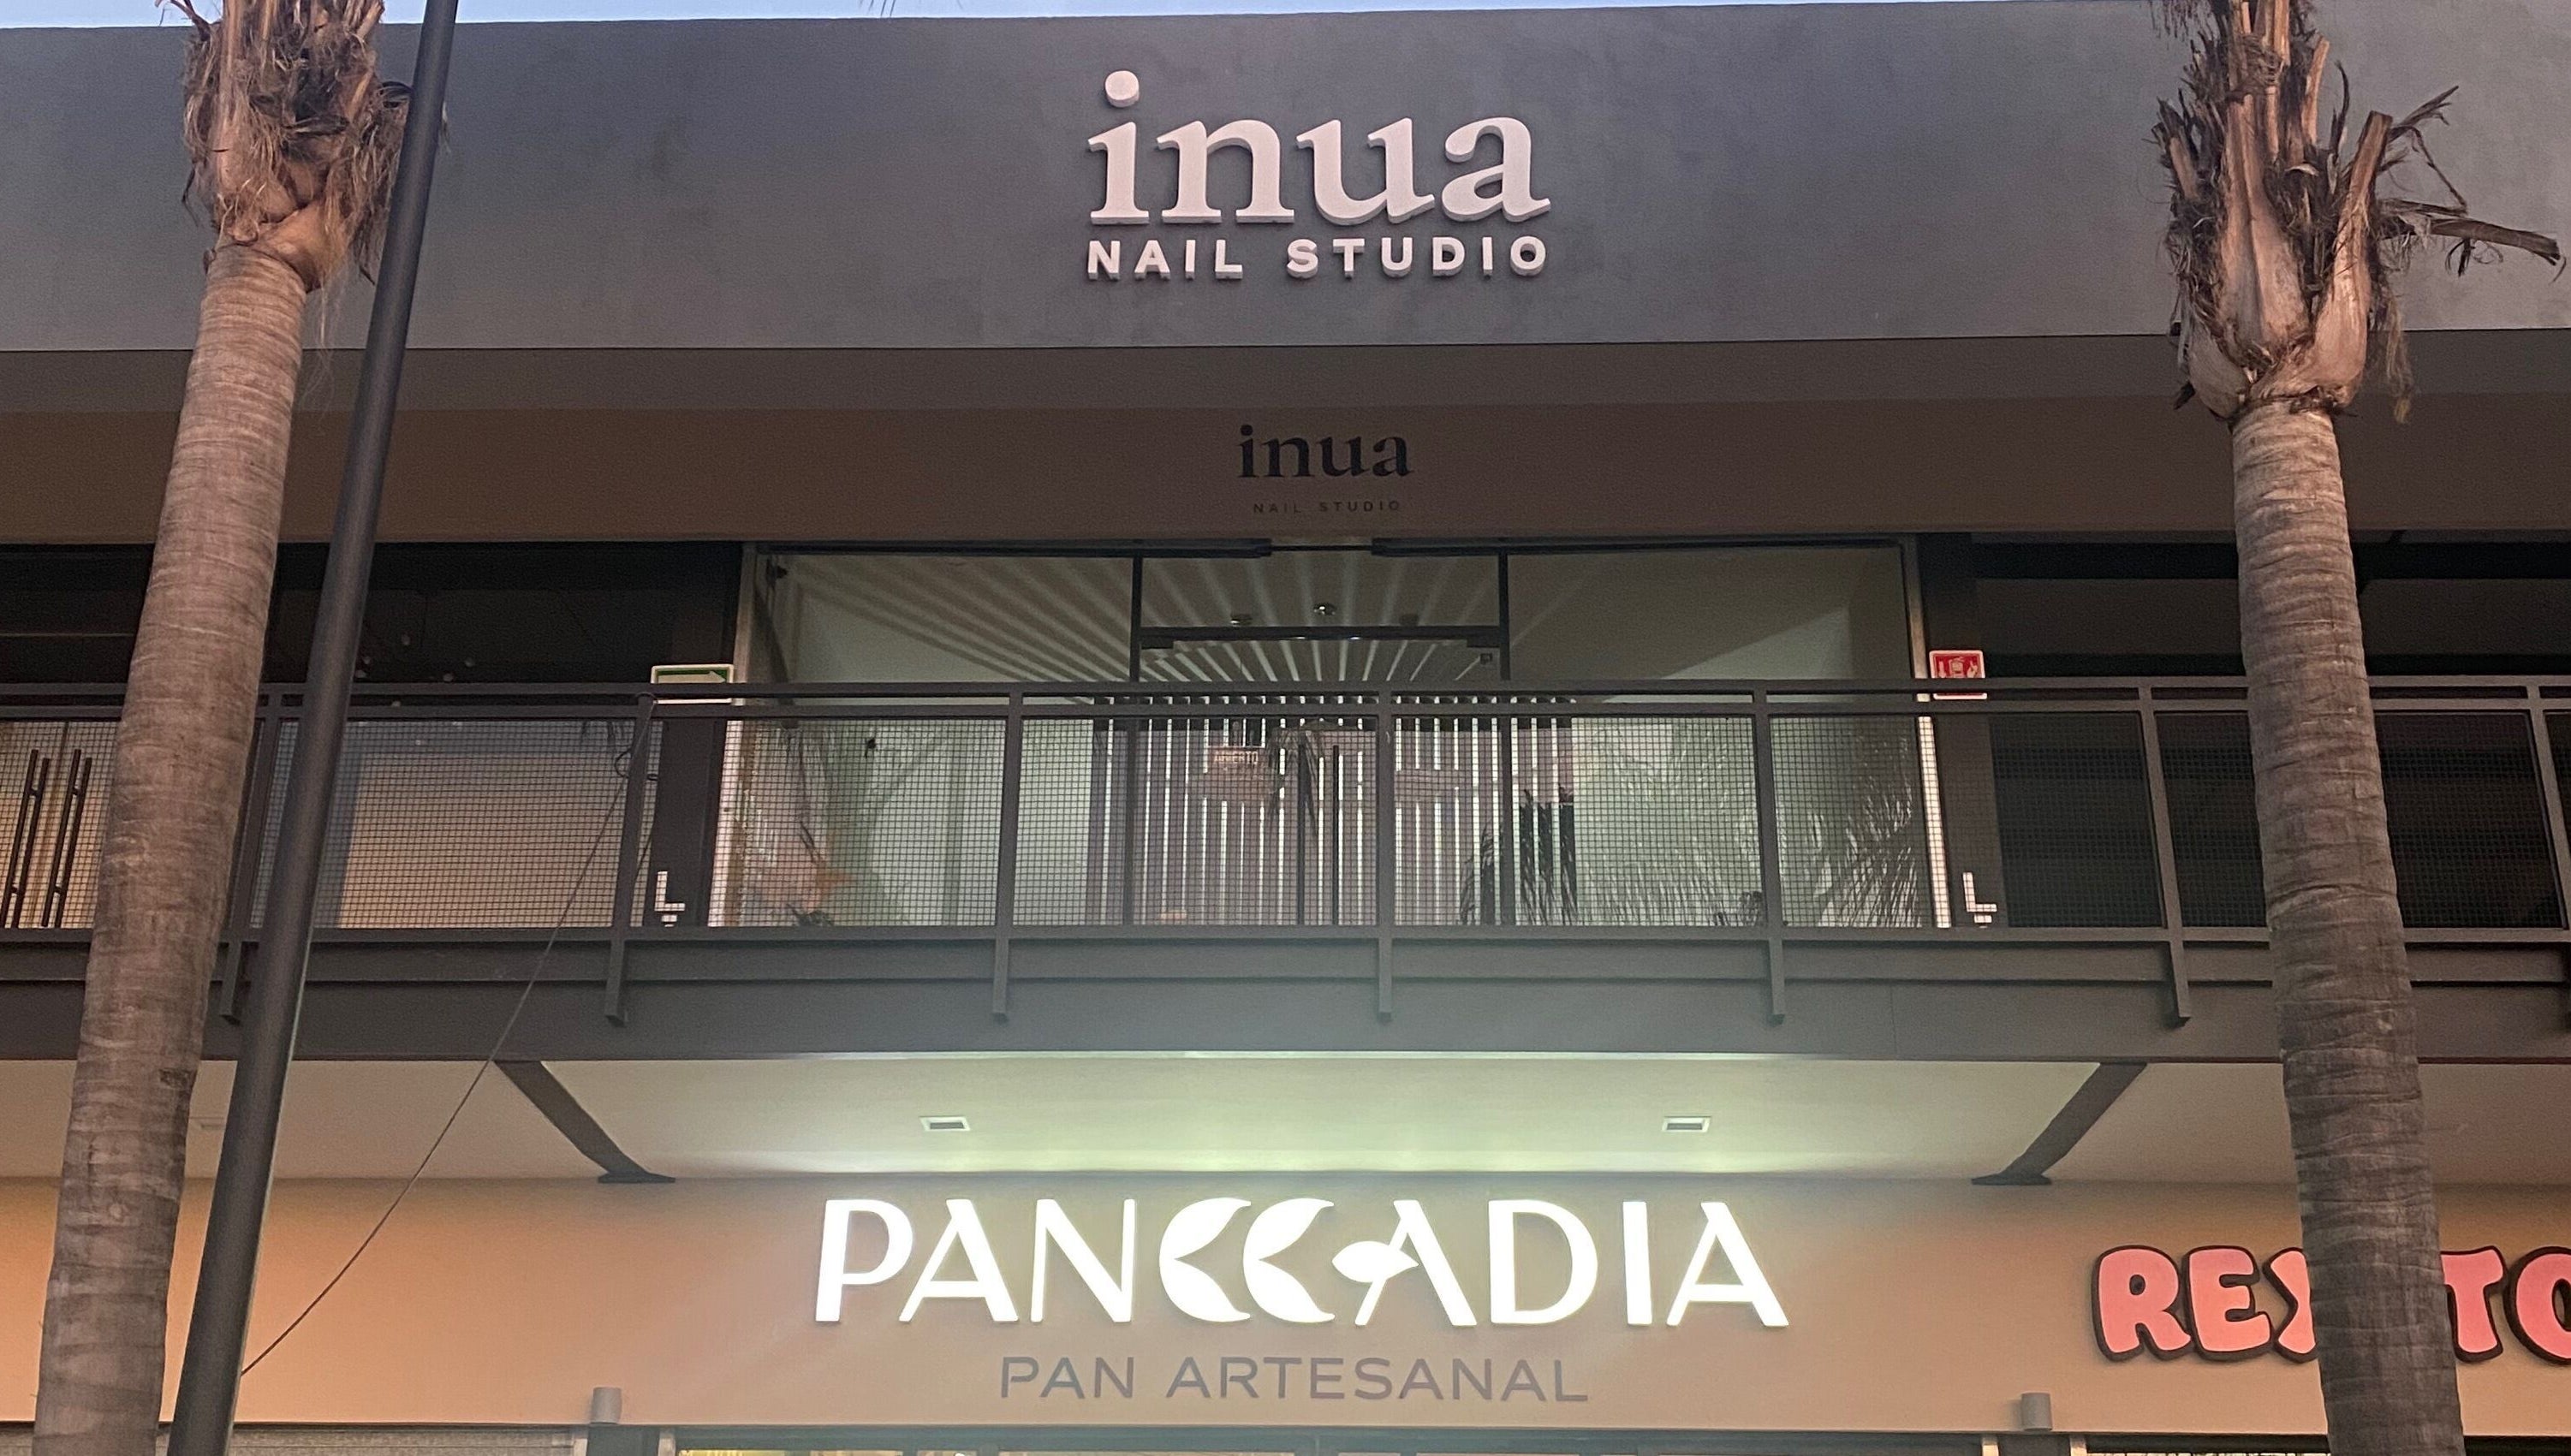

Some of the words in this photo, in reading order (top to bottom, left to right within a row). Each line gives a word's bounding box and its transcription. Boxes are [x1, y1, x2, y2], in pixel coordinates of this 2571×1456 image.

[1088, 70, 1551, 225] inua
[1087, 239, 1243, 280] NAIL
[1286, 235, 1547, 279] STUDIO
[1237, 424, 1414, 478] inua
[1253, 501, 1302, 514] NAIL
[1318, 500, 1400, 513] STUDIO
[1001, 1356, 1134, 1399] PAN
[1165, 1356, 1589, 1402] ARTESANAL
